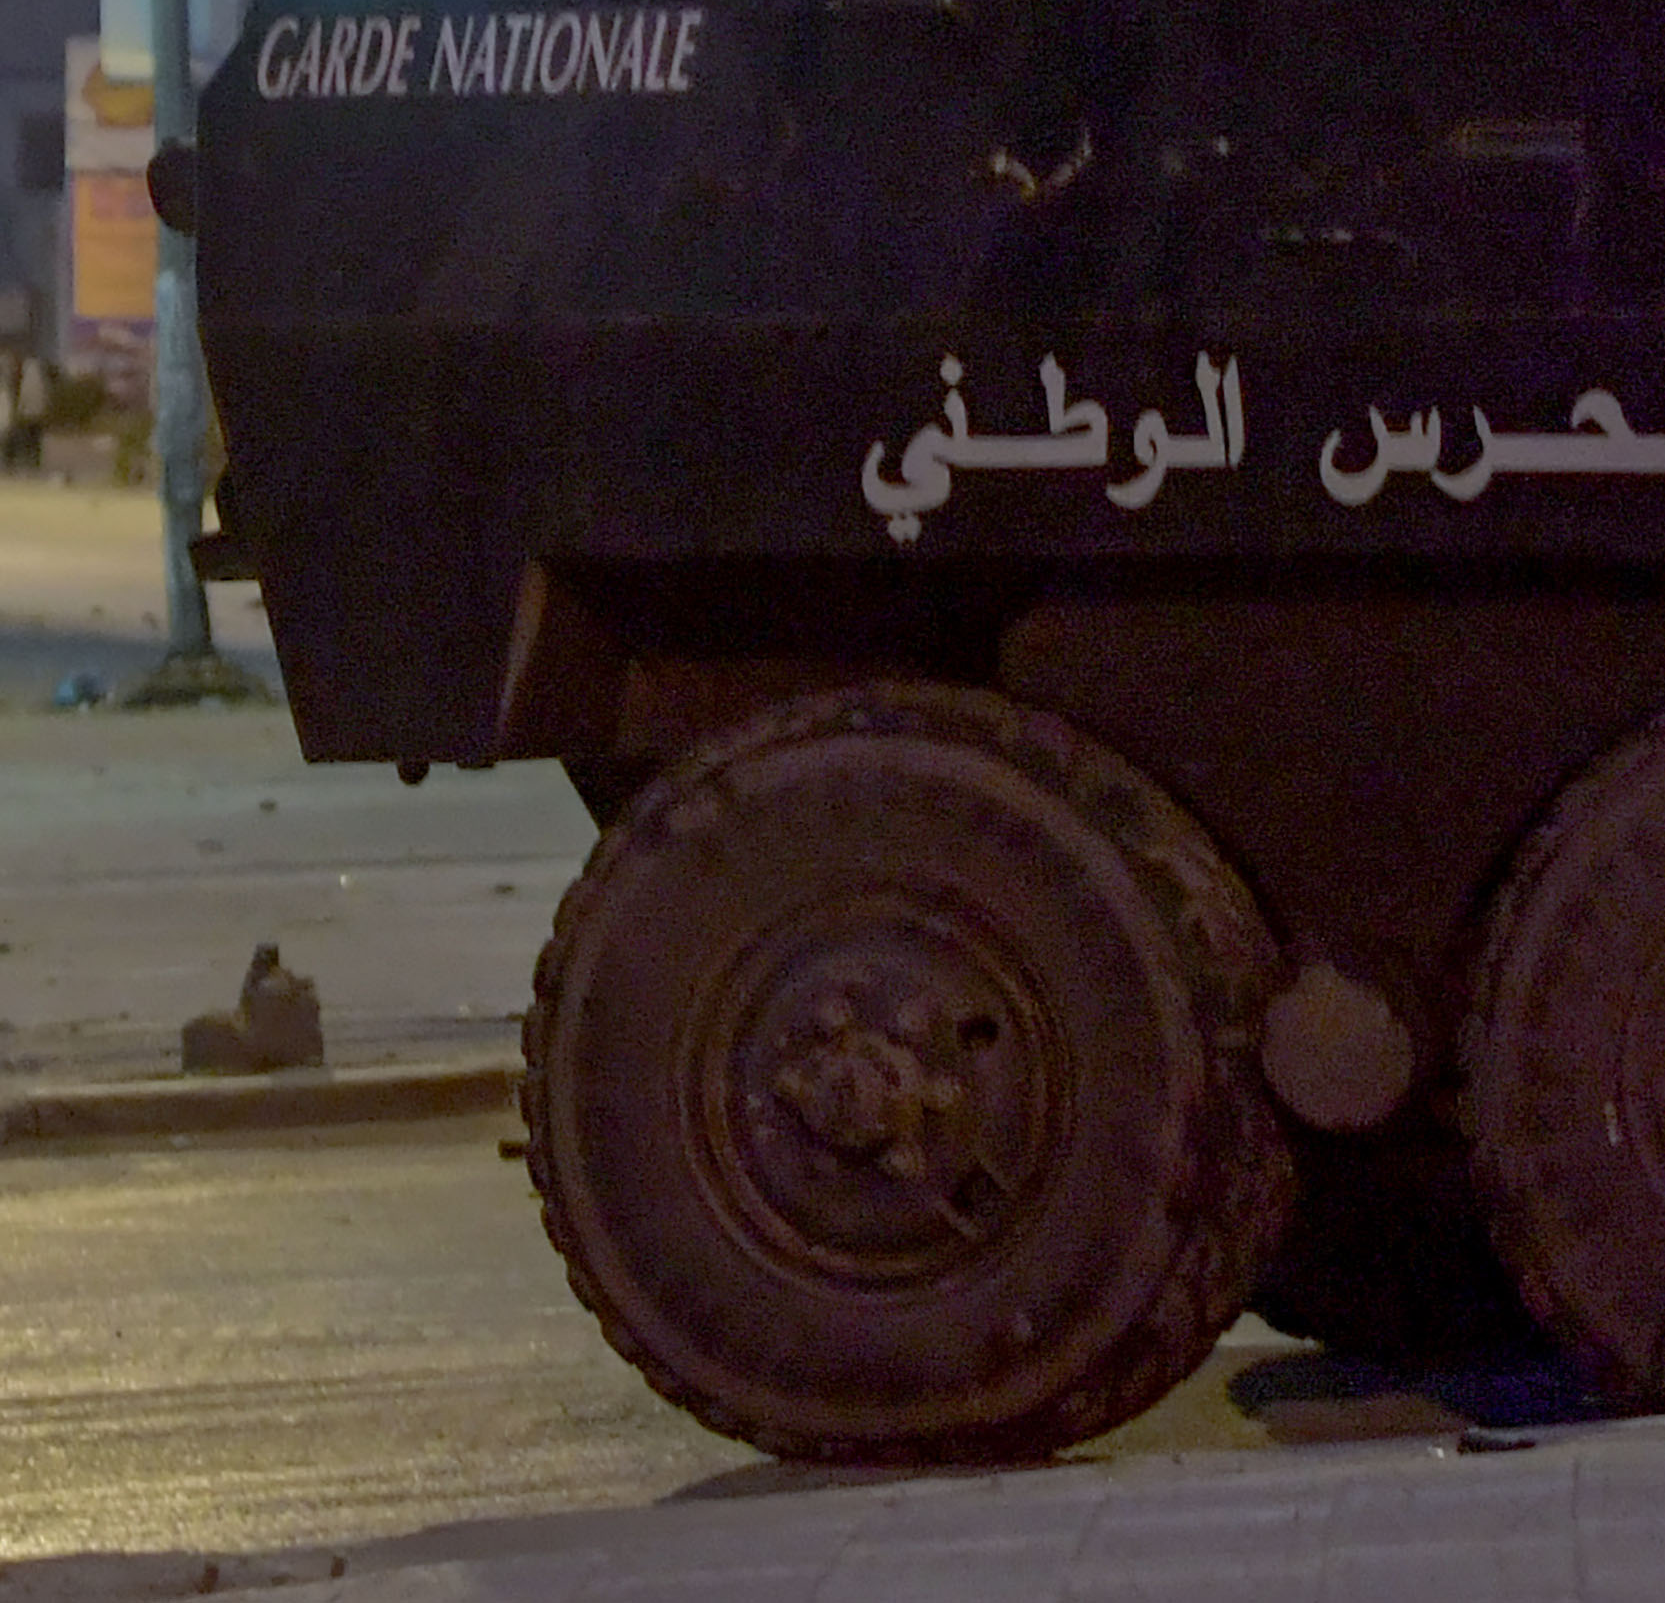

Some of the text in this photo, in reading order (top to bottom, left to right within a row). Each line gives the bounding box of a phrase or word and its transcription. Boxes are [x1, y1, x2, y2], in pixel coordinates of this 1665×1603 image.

[257, 8, 705, 99] GARDE NATIONALE
[859, 350, 1246, 543] الوطني
